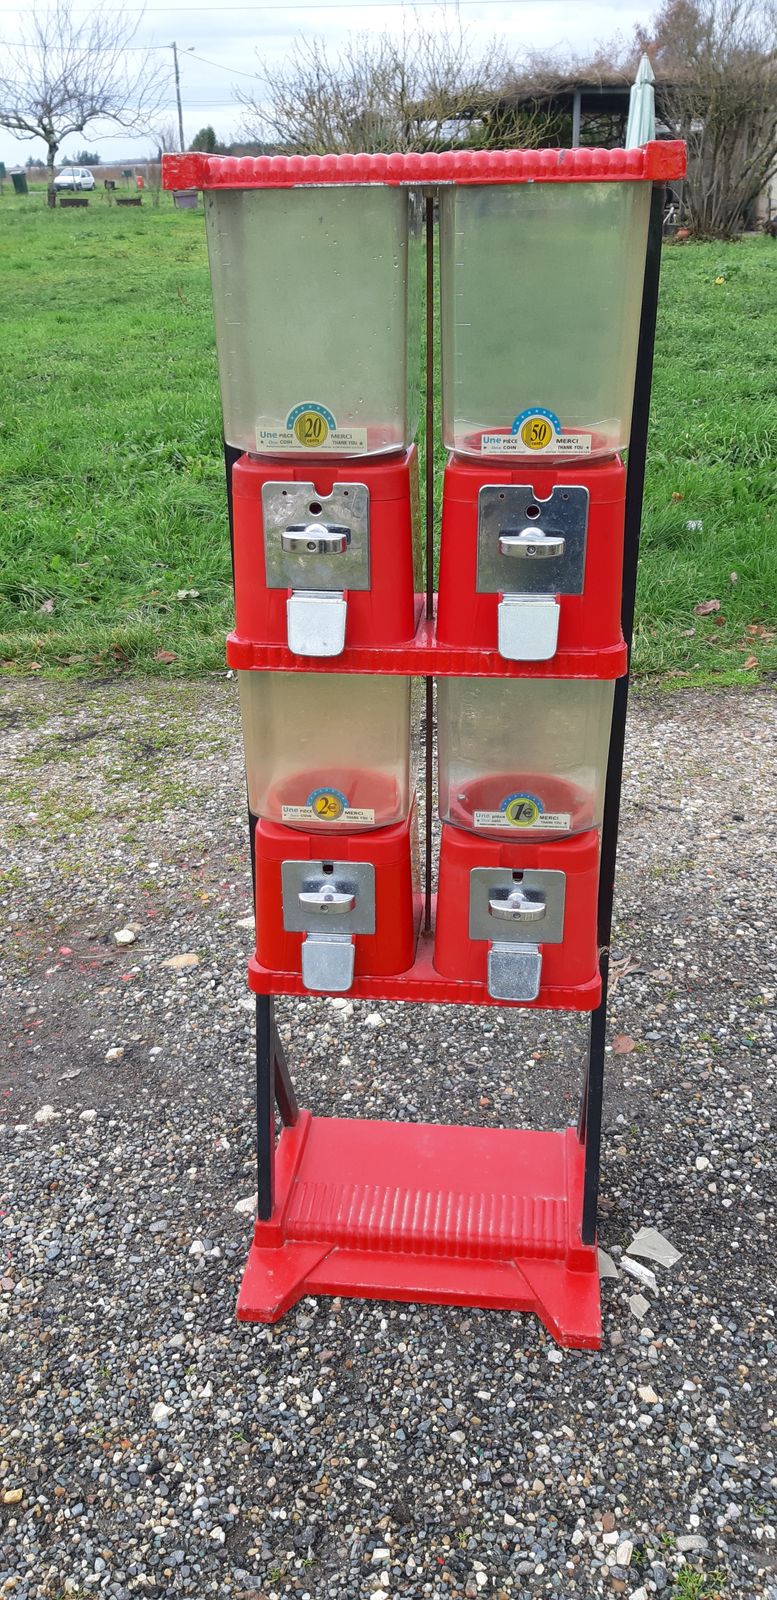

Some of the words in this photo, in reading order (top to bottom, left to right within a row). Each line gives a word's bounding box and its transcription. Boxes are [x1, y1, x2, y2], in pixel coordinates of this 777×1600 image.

[304, 418, 322, 438] 20
[531, 424, 547, 442] 50
[318, 797, 337, 814] 2€
[512, 804, 533, 820] 1€
